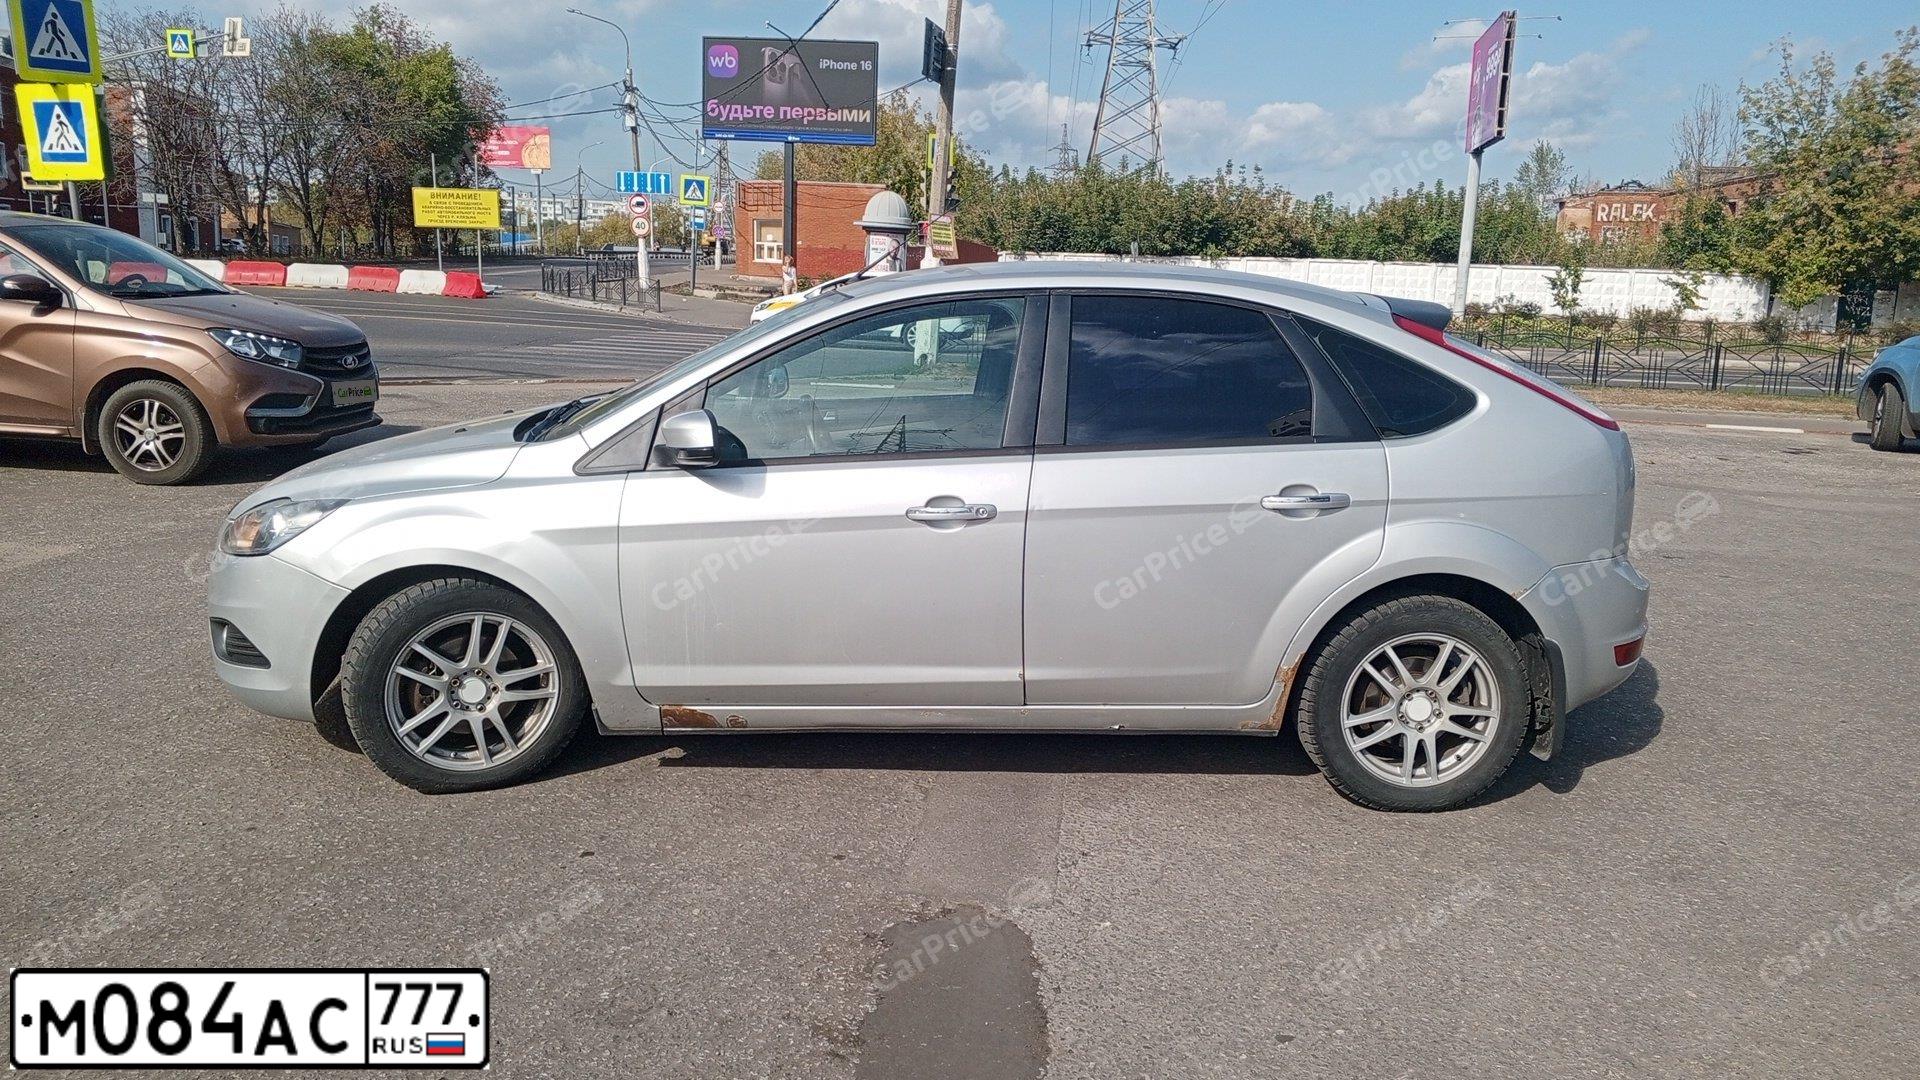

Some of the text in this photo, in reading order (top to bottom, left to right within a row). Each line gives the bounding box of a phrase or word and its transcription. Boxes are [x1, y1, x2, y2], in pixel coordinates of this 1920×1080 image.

[710, 52, 736, 68] wb
[819, 59, 872, 70] iPhone 16
[707, 99, 870, 124] будьте первыми
[430, 192, 481, 200] ВНИМАНИЕ!
[636, 221, 646, 230] 40
